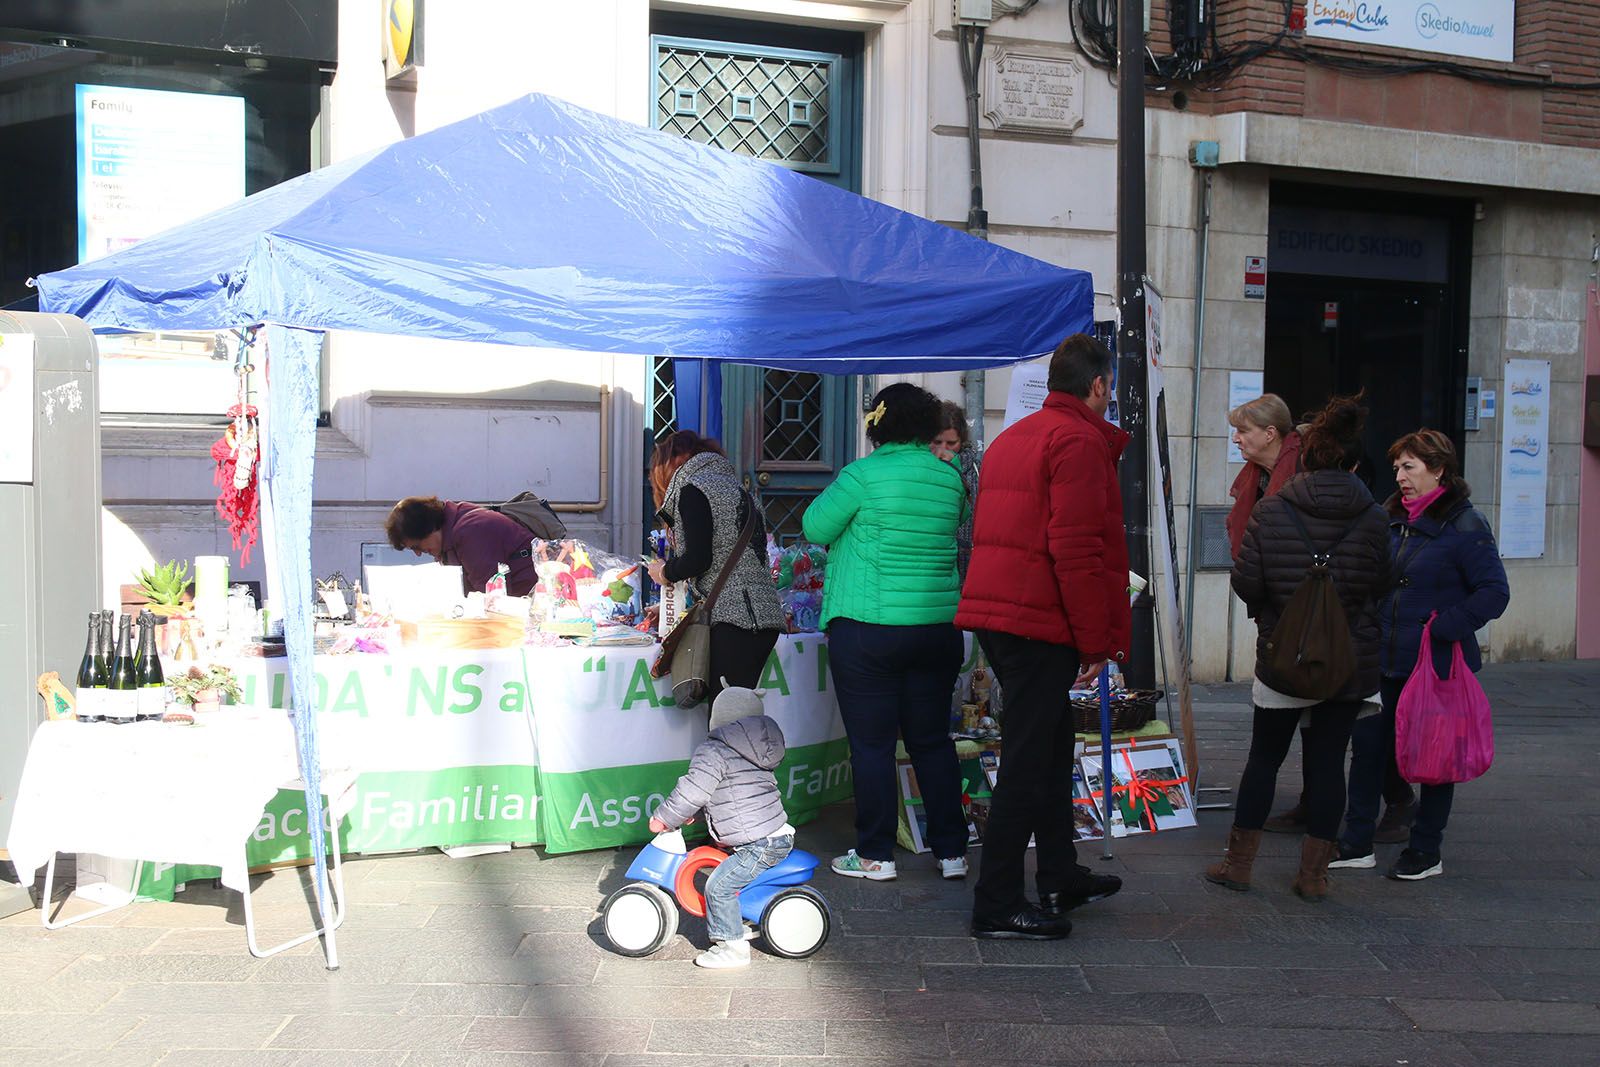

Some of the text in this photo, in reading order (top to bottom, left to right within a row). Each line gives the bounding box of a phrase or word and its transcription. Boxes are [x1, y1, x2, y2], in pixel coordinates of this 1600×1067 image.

[91, 99, 134, 114] Family
[1277, 229, 1424, 259] EDIFICIO SKEDIO
